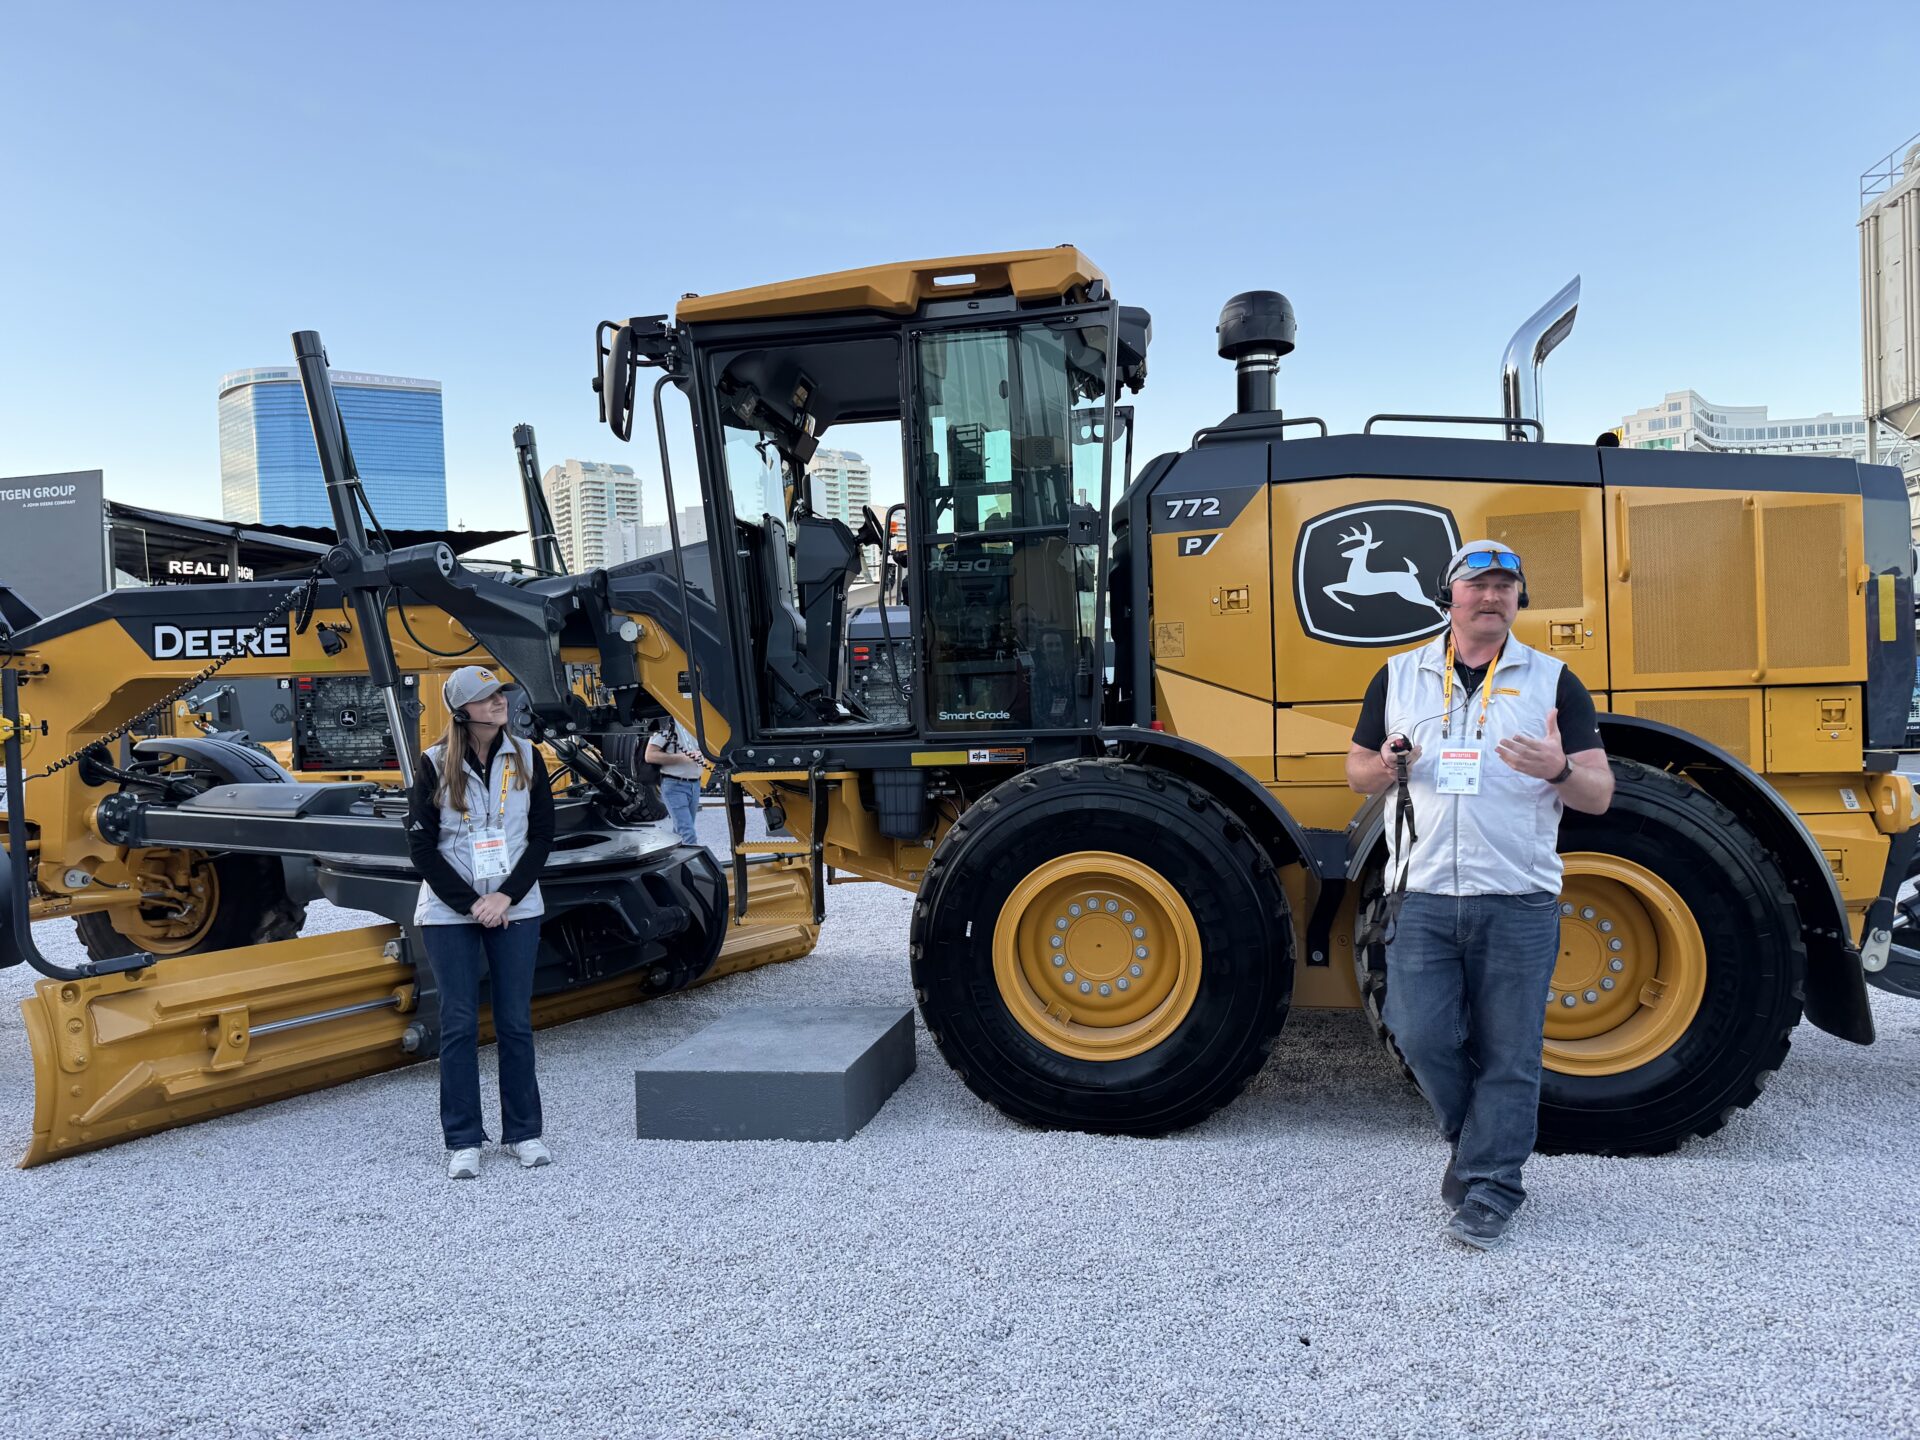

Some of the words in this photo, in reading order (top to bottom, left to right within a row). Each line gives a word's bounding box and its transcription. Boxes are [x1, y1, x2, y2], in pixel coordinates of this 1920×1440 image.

[0, 488, 31, 501] TGEN
[33, 484, 76, 499] GROUP
[1166, 497, 1220, 519] 772
[168, 560, 217, 576] REAL
[154, 625, 288, 658] DEERE
